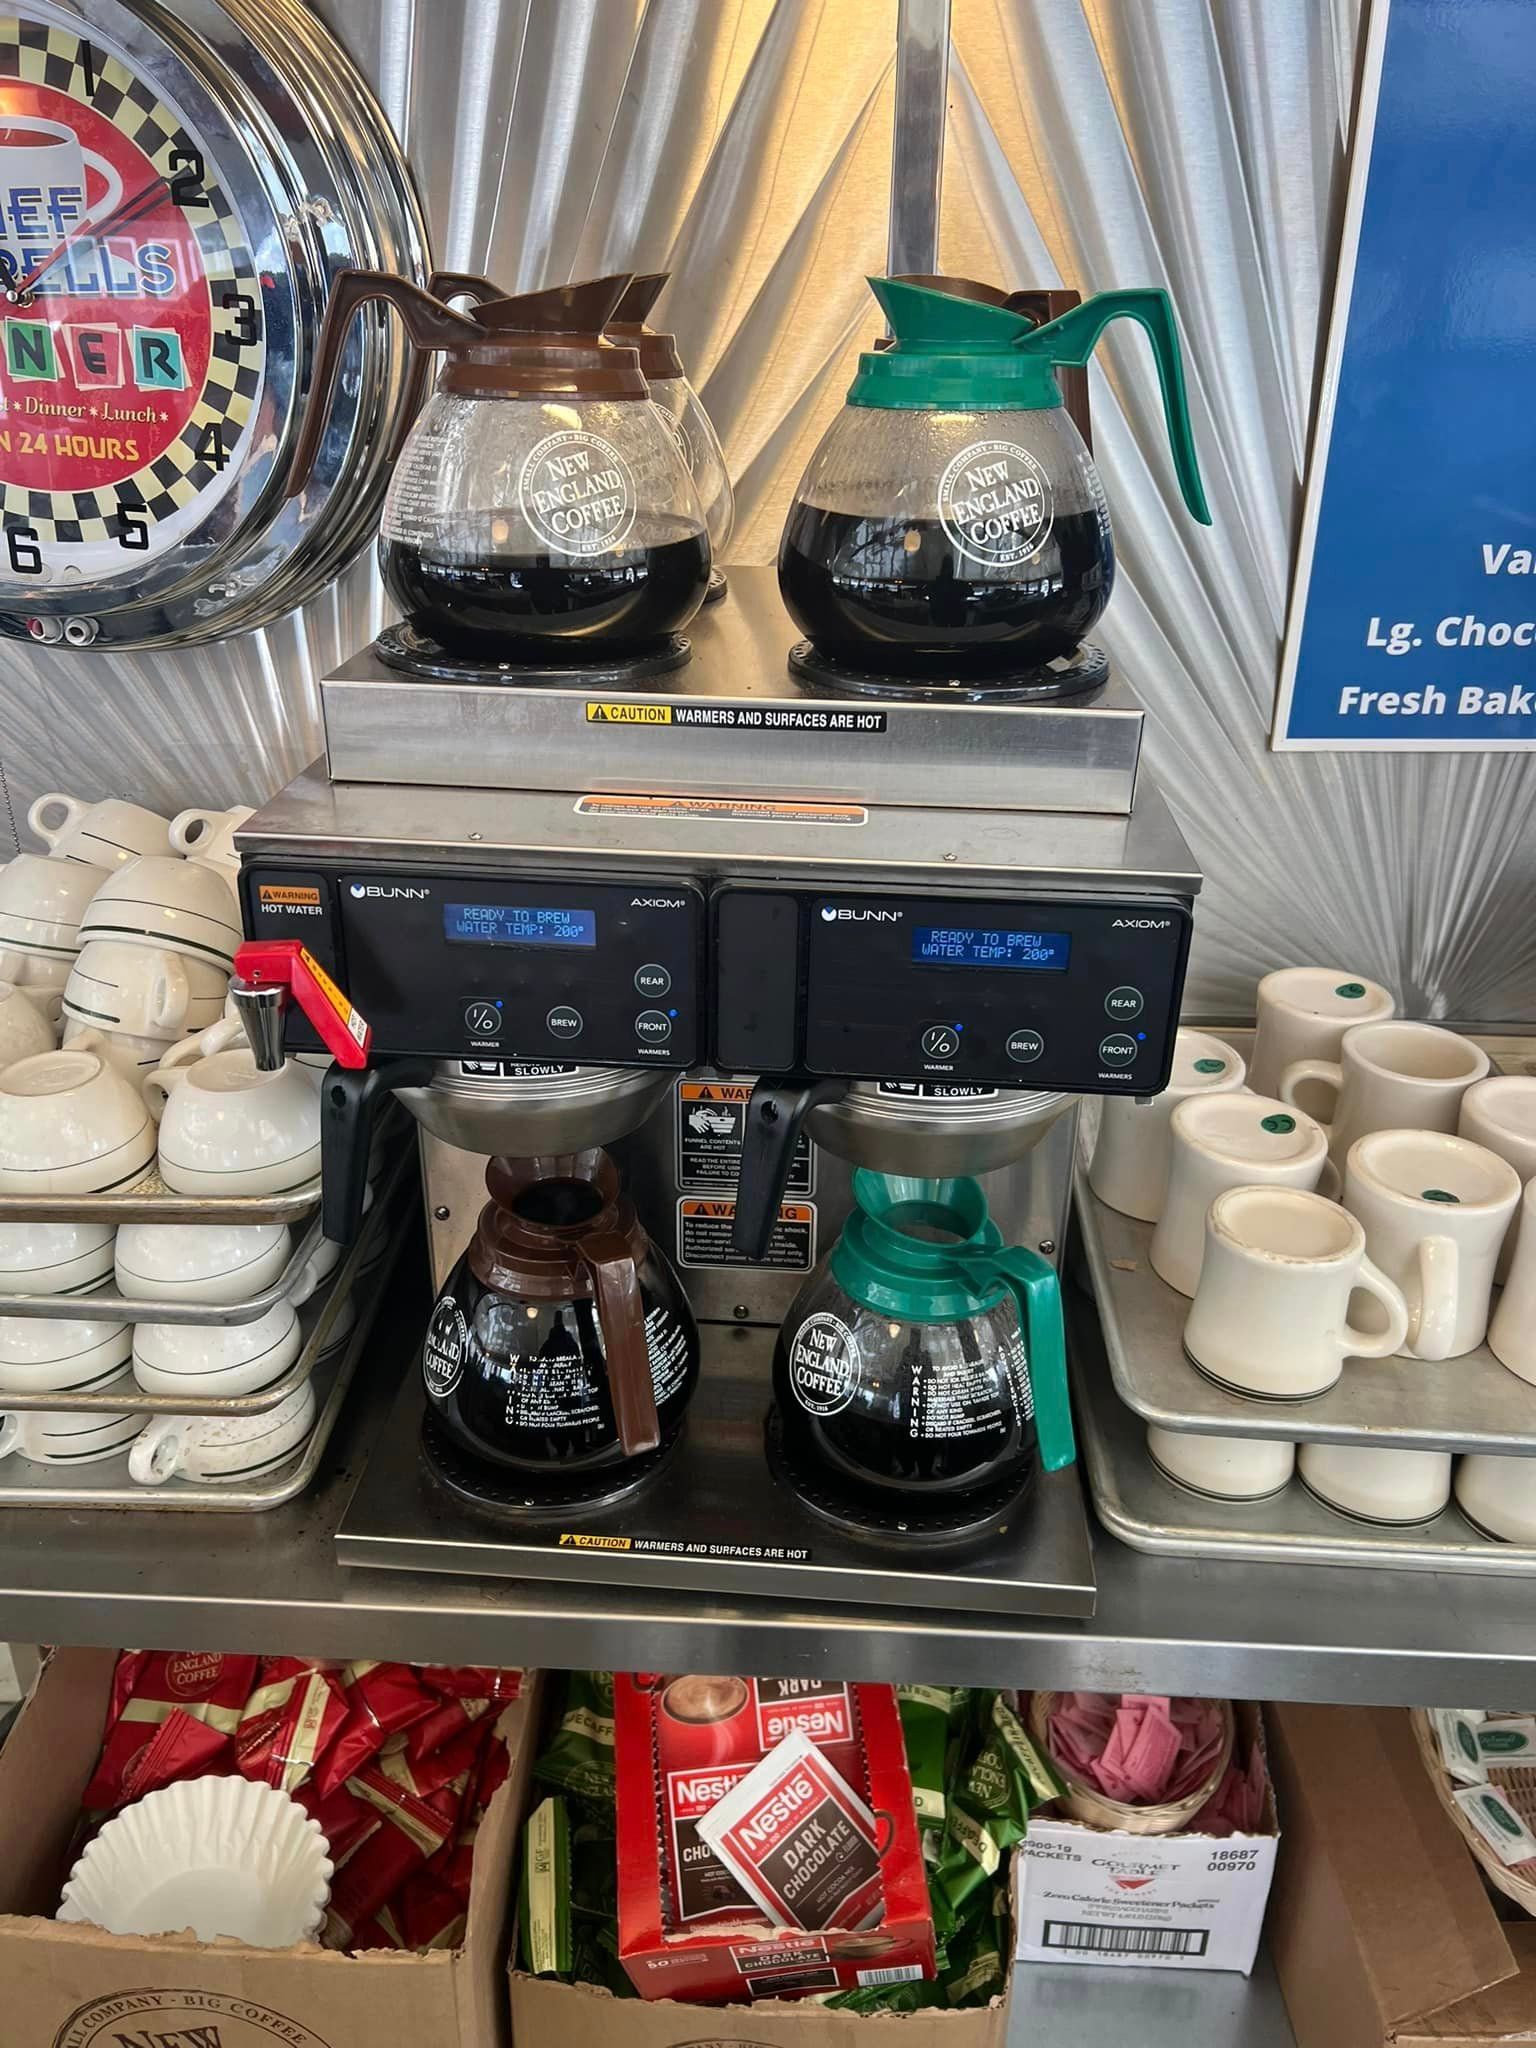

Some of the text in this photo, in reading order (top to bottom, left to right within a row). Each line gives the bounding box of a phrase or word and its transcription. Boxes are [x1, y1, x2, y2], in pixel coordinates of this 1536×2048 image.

[169, 149, 210, 208] 2
[223, 294, 257, 346] 3
[25, 396, 87, 418] Dinner
[101, 402, 158, 423] Lunch
[19, 431, 48, 454] 24
[55, 434, 139, 461] HOURS
[195, 423, 230, 471] 4
[545, 450, 591, 482] NEW
[965, 460, 1009, 492] NEW
[533, 469, 622, 514] ENGLAND
[952, 478, 1040, 525] ENGLAND
[552, 495, 624, 534] COFFEE
[970, 503, 1041, 545] COFFEE
[117, 503, 150, 551] 5
[8, 527, 42, 575] 6
[1482, 544, 1536, 575] Va
[1366, 615, 1536, 655] Lg. Choc
[1338, 685, 1536, 715] Fresh Bak
[611, 705, 881, 729] CAUTION WARMERS AND SURFACES ARE HOT
[273, 891, 318, 900] WARNING
[261, 904, 323, 915] HOT WATER
[464, 908, 570, 925] READY TO BREW
[456, 921, 497, 934] WATER
[505, 923, 544, 936] TEMP:
[931, 931, 1042, 947] READY TO BREW
[922, 944, 964, 957] WATER
[973, 945, 1012, 958] TEMP:
[640, 976, 664, 986] REAR
[1111, 1000, 1136, 1008] REAR
[551, 1018, 577, 1028] BREW
[638, 1022, 668, 1032] FRONT
[637, 1048, 671, 1056] WARMERS
[1011, 1041, 1039, 1051] BREW
[1102, 1046, 1133, 1055] FRONT
[514, 1065, 564, 1076] SLOWLY
[923, 1064, 954, 1072] WARMER
[1098, 1072, 1133, 1080] WARMERS
[933, 1087, 983, 1097] SLOWLY
[810, 1328, 837, 1352] NEW
[796, 1344, 850, 1377] ENGLAND
[797, 1366, 842, 1396] COFFEE
[578, 1537, 808, 1559] CAUTION WARMERS AND SURFACES ARE HOT
[173, 1652, 222, 1673] ENGLAND
[176, 1665, 218, 1685] COFFEE
[782, 1818, 827, 1870] DARK
[783, 1820, 851, 1899] CHOCOLATE
[1091, 1858, 1181, 1871] GOURMET
[1211, 1850, 1259, 1860] 18687
[1207, 1861, 1256, 1871] 00970
[1042, 1890, 1070, 1900] Zero
[745, 1953, 819, 1969] CHOCOLATE
[82, 1995, 163, 2029] COMPANY
[183, 1995, 221, 2009] BIG
[230, 2003, 308, 2043] COFFEE
